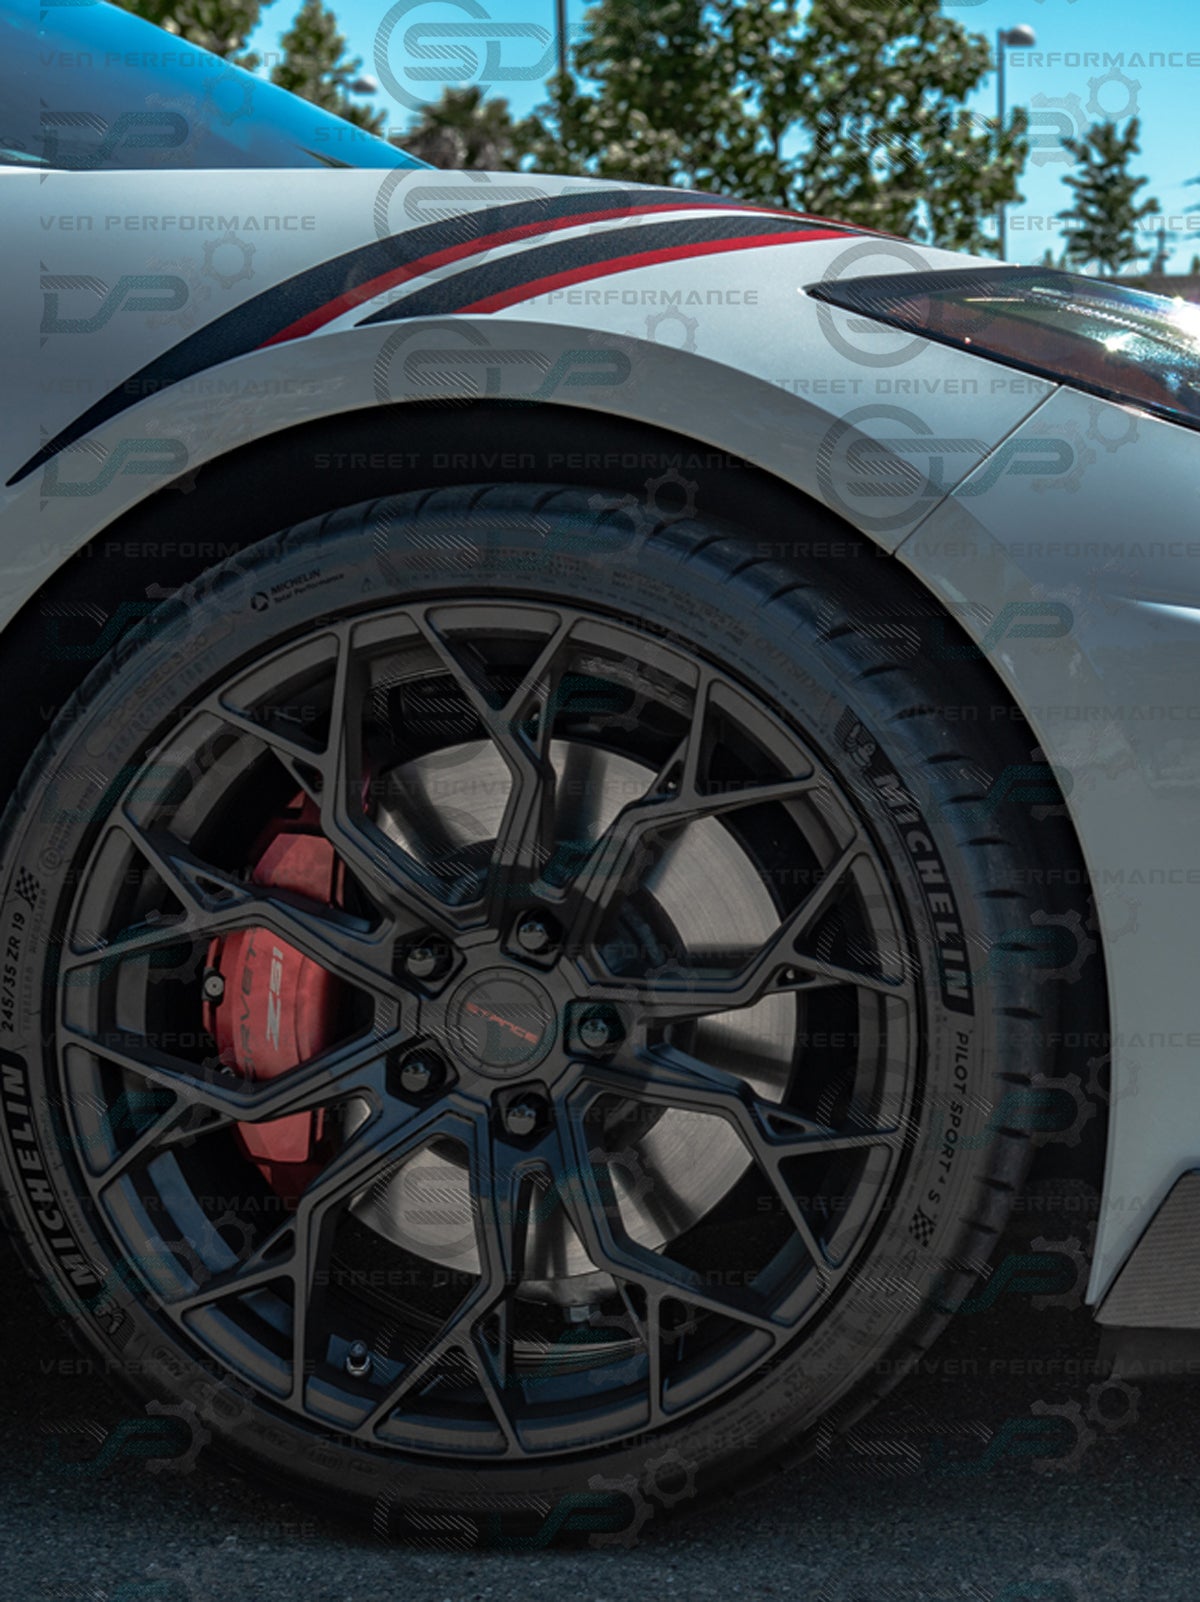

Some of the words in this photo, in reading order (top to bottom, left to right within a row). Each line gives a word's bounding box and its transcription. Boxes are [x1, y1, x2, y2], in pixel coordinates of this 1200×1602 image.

[269, 568, 322, 595] MICHELIN
[874, 775, 971, 999] MICHELIN
[6, 935, 21, 961] ZR
[12, 911, 26, 931] 19
[1, 963, 18, 1033] 245/35
[266, 946, 284, 1052] Z51
[465, 1001, 539, 1046] STANCE
[955, 1032, 970, 1094] PILOT
[938, 1099, 965, 1174] SPORT
[3, 1068, 97, 1287] MICHELIN
[926, 1187, 942, 1206] S
